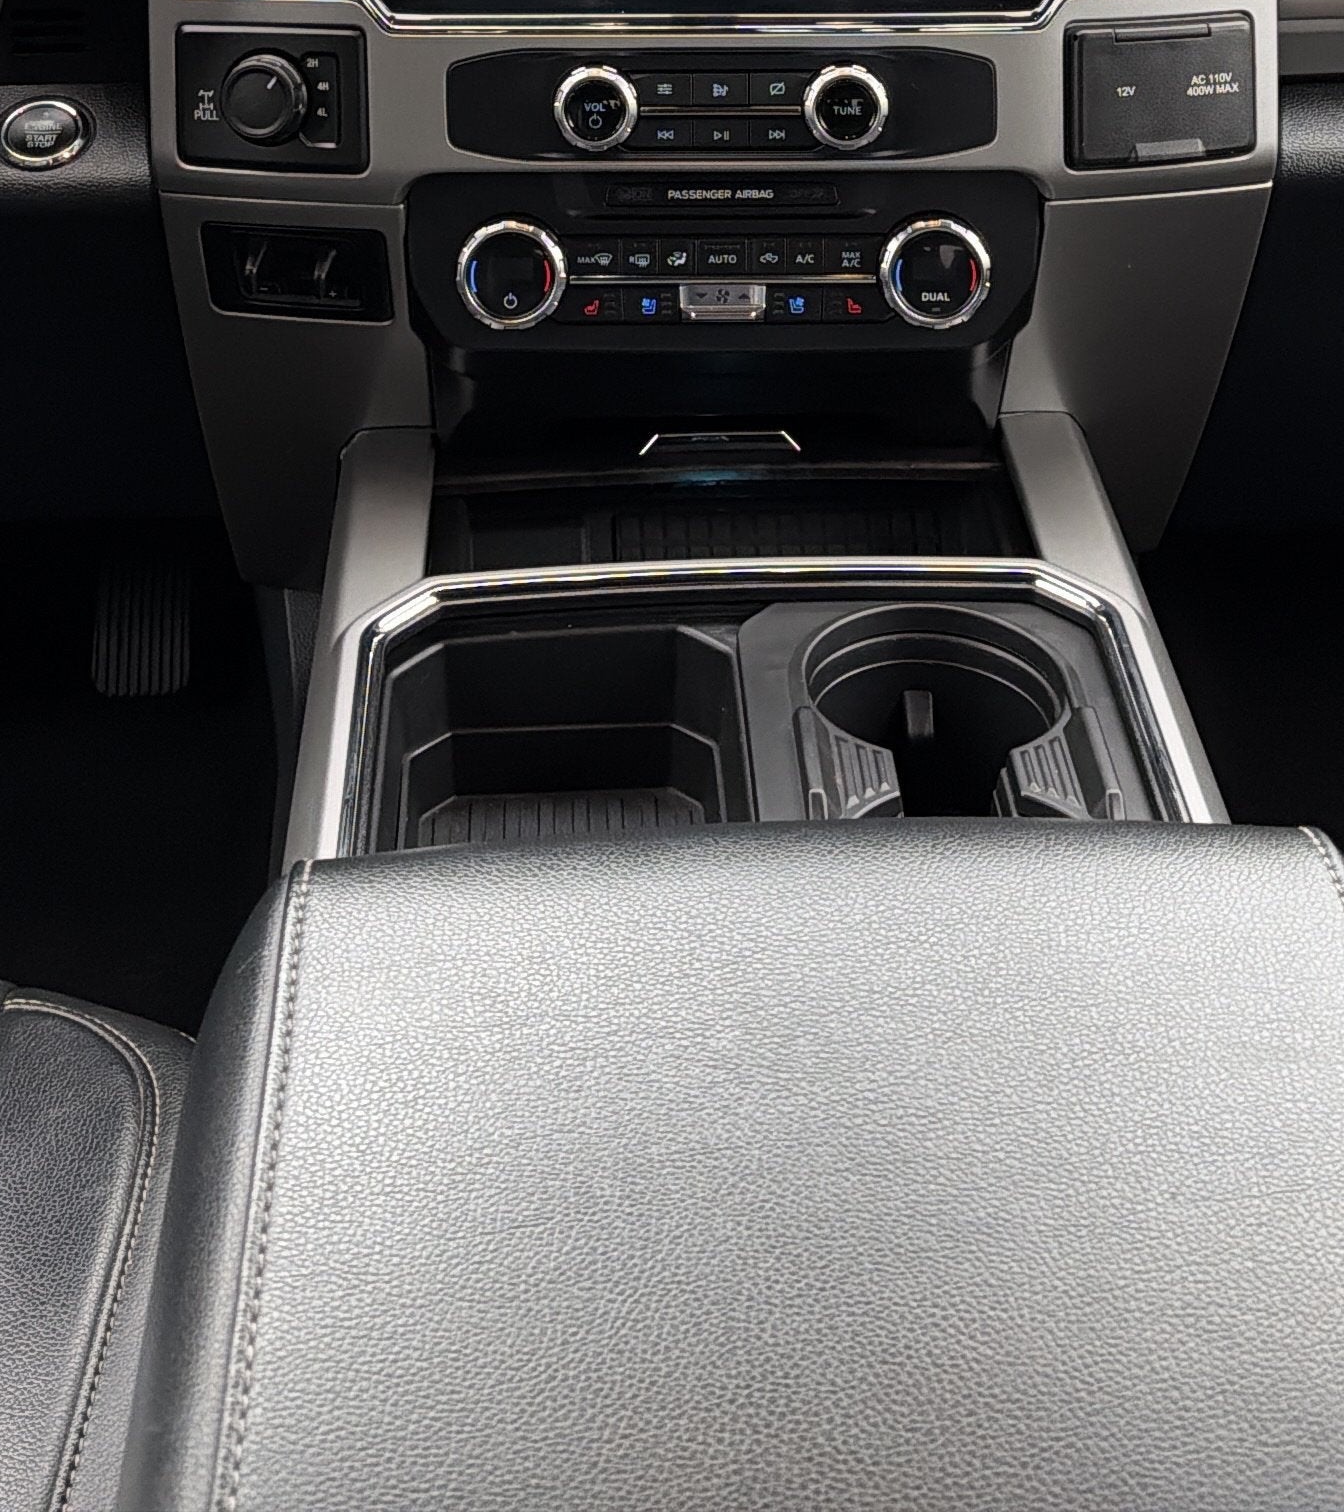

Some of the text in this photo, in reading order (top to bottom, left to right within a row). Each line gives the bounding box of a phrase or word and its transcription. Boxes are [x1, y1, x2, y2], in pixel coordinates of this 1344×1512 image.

[306, 58, 318, 68] 2H
[1190, 72, 1233, 85] AC 110V
[316, 81, 329, 91] 4H
[1186, 82, 1239, 97] 400W MAX
[1116, 86, 1136, 98] 12V
[316, 107, 328, 117] 4L
[583, 101, 606, 113] VOL
[833, 104, 863, 116] TUNE
[194, 109, 220, 121] PULL
[24, 133, 59, 142] START
[26, 141, 55, 149] STOP
[667, 189, 732, 200] PASSENGER
[735, 189, 774, 200] AIRBAG
[577, 255, 596, 264] MAX
[708, 254, 737, 264] AUTO
[795, 253, 815, 264] A/C
[841, 251, 860, 259] MAX
[841, 258, 862, 268] A/C
[920, 291, 951, 303] DUAL
